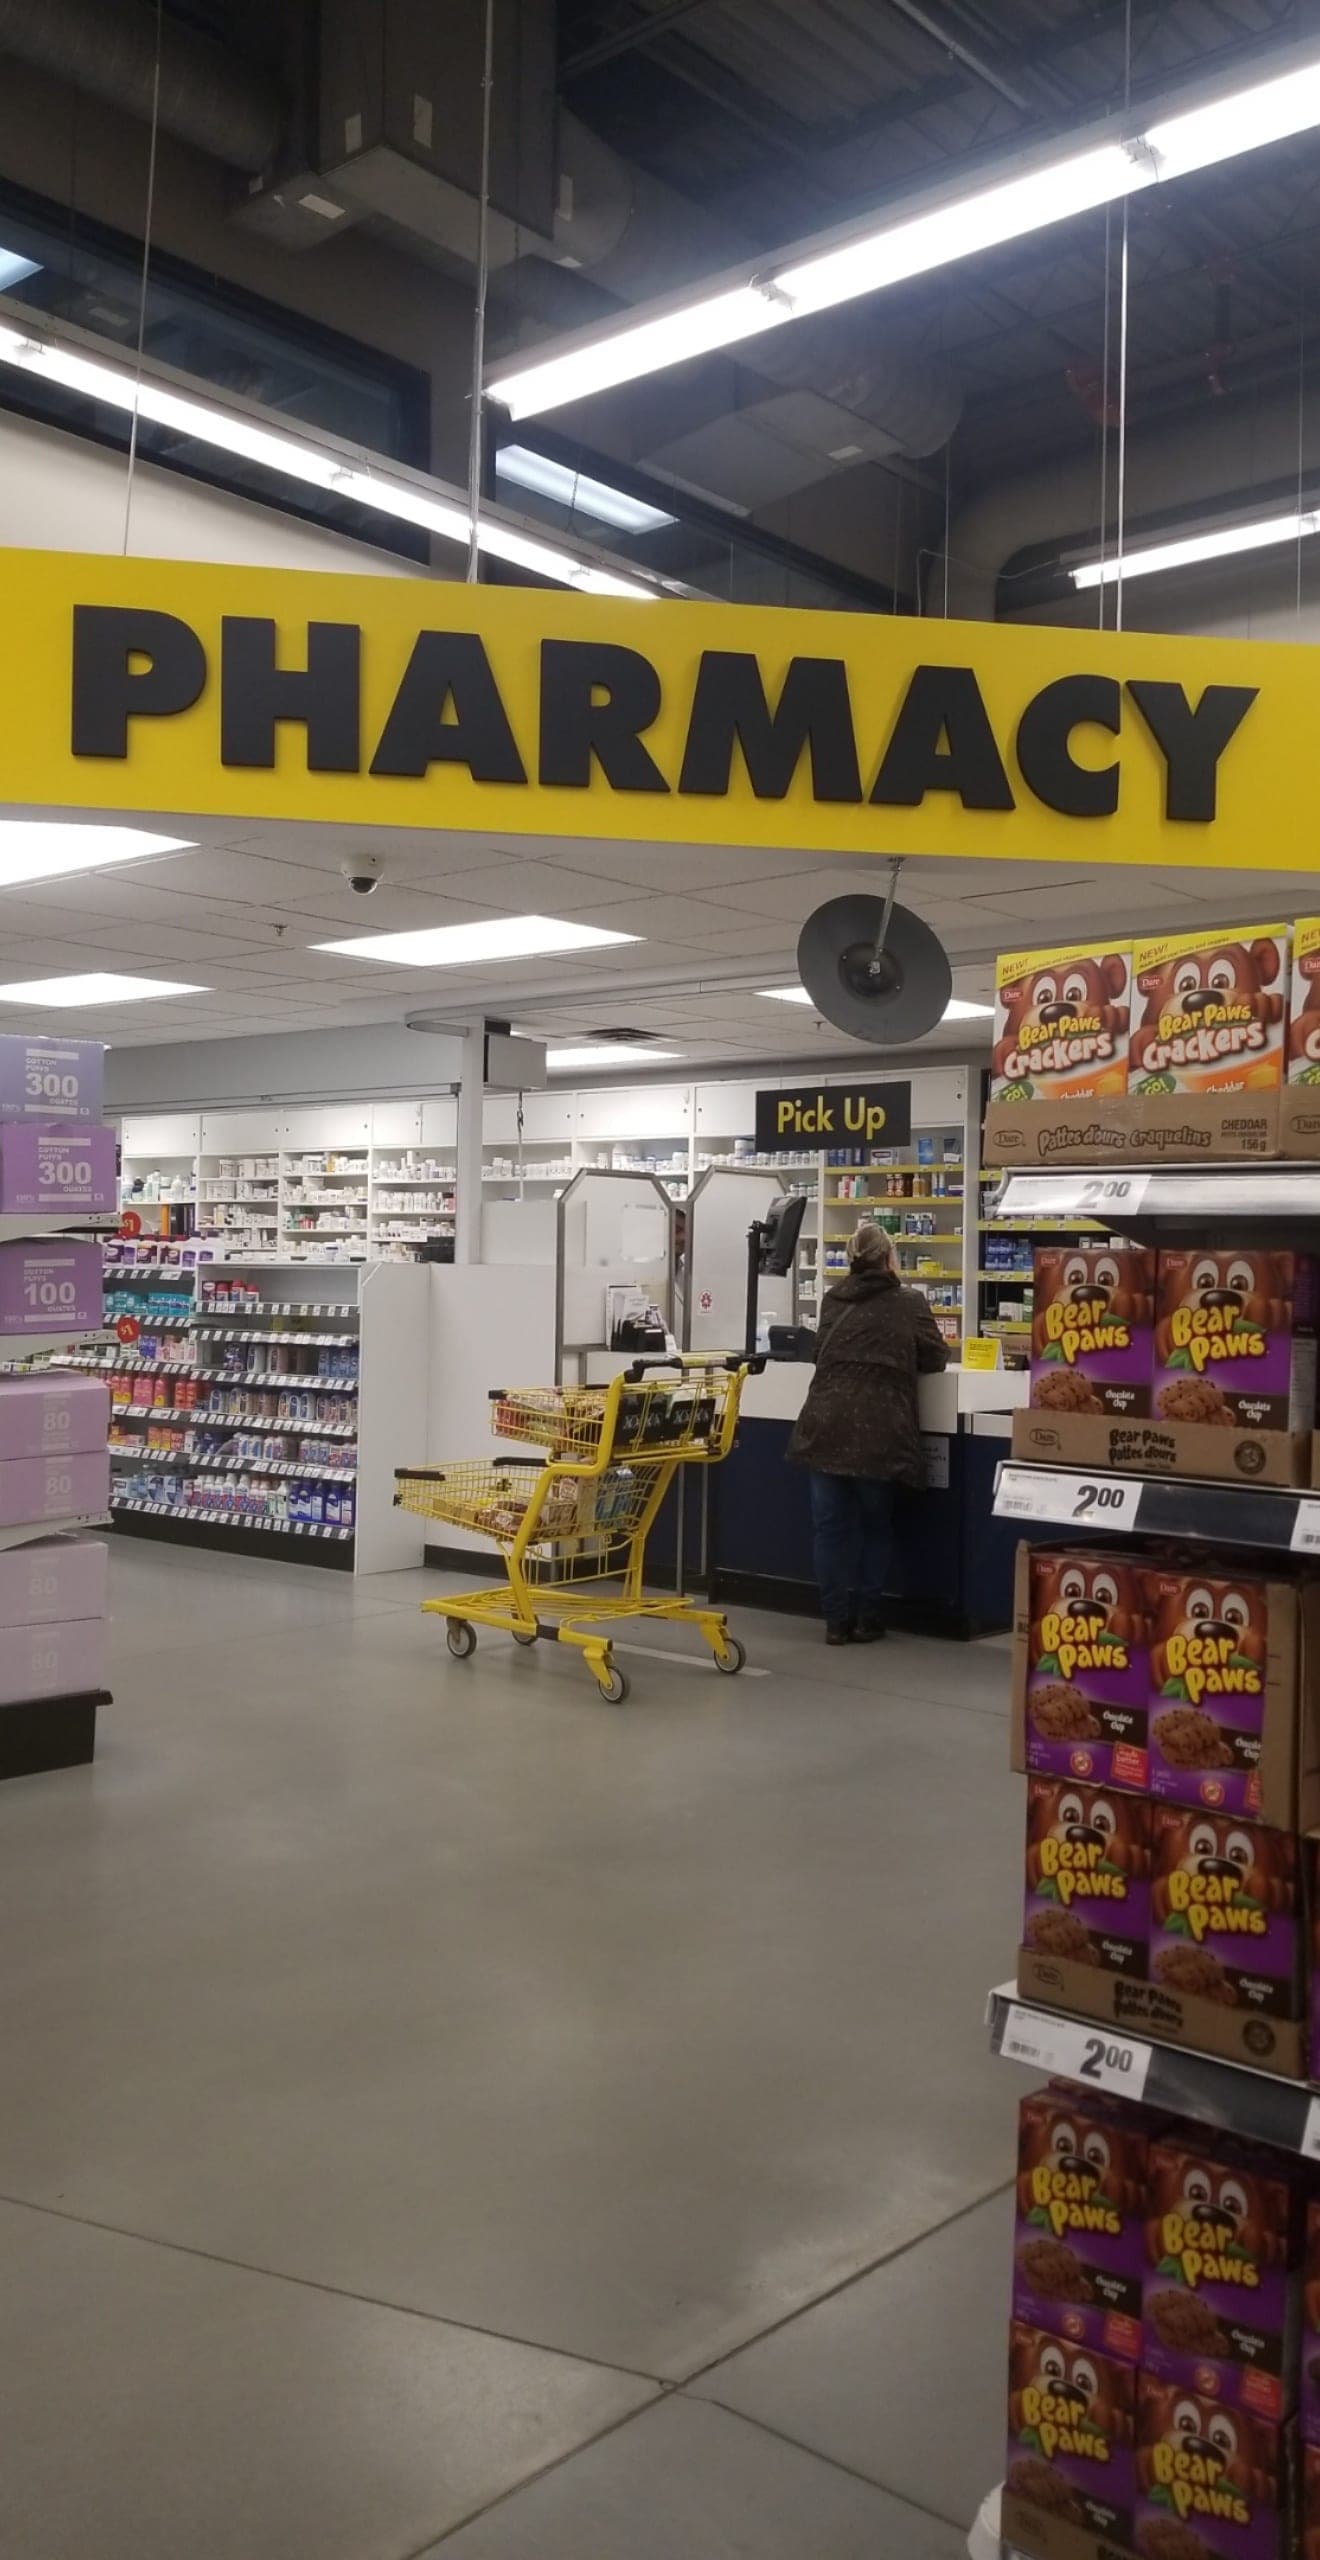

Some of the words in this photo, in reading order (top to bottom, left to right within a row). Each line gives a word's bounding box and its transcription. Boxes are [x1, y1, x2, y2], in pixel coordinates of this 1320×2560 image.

[71, 603, 1261, 823] PHARMACY
[1018, 1020, 1059, 1050] Bear
[1059, 1015, 1102, 1038] Paws
[1158, 1009, 1203, 1041] Bear
[1203, 1003, 1252, 1027] Paws
[1004, 1030, 1113, 1079] Crackers
[1142, 1021, 1266, 1072] Crackers
[25, 1073, 79, 1099] 300
[777, 1095, 834, 1134] Pick
[844, 1096, 887, 1141] Up
[1221, 1119, 1268, 1131] CHEDDAR
[998, 1132, 1020, 1144] Dare
[1038, 1125, 1081, 1157] Pattes
[1082, 1124, 1126, 1149] d'ours
[1130, 1125, 1212, 1151] Craquelins
[38, 1162, 93, 1186] 300
[24, 1282, 76, 1306] 100
[1045, 1300, 1106, 1341] Bear
[1171, 1305, 1240, 1347] Bear
[1061, 1325, 1129, 1364] Paws
[1189, 1333, 1265, 1373] Paws
[43, 1411, 71, 1432] 80
[1109, 1428, 1141, 1446] Bear
[1142, 1429, 1176, 1449] Paws
[46, 1475, 72, 1496] 80
[30, 1575, 57, 1596] 80
[1041, 1613, 1105, 1652] Bear
[31, 1650, 58, 1672] 80
[1058, 1643, 1128, 1679] Paws
[1166, 1635, 1236, 1677] Bear
[1184, 1667, 1262, 1704] Paws
[1040, 1837, 1103, 1877] Bear
[1057, 1869, 1126, 1905] Paws
[1168, 1870, 1240, 1911] Bear
[1187, 1903, 1266, 1942] Paws
[1032, 2166, 1097, 2203] Bear
[1049, 2201, 1122, 2236] Paws
[1162, 2213, 1236, 2252] Bear
[1182, 2252, 1261, 2288] Paws
[1022, 2386, 1086, 2428] Bear
[1038, 2422, 1110, 2459] Paws
[1153, 2440, 1225, 2485] Bear
[1172, 2479, 1250, 2526] Paws
